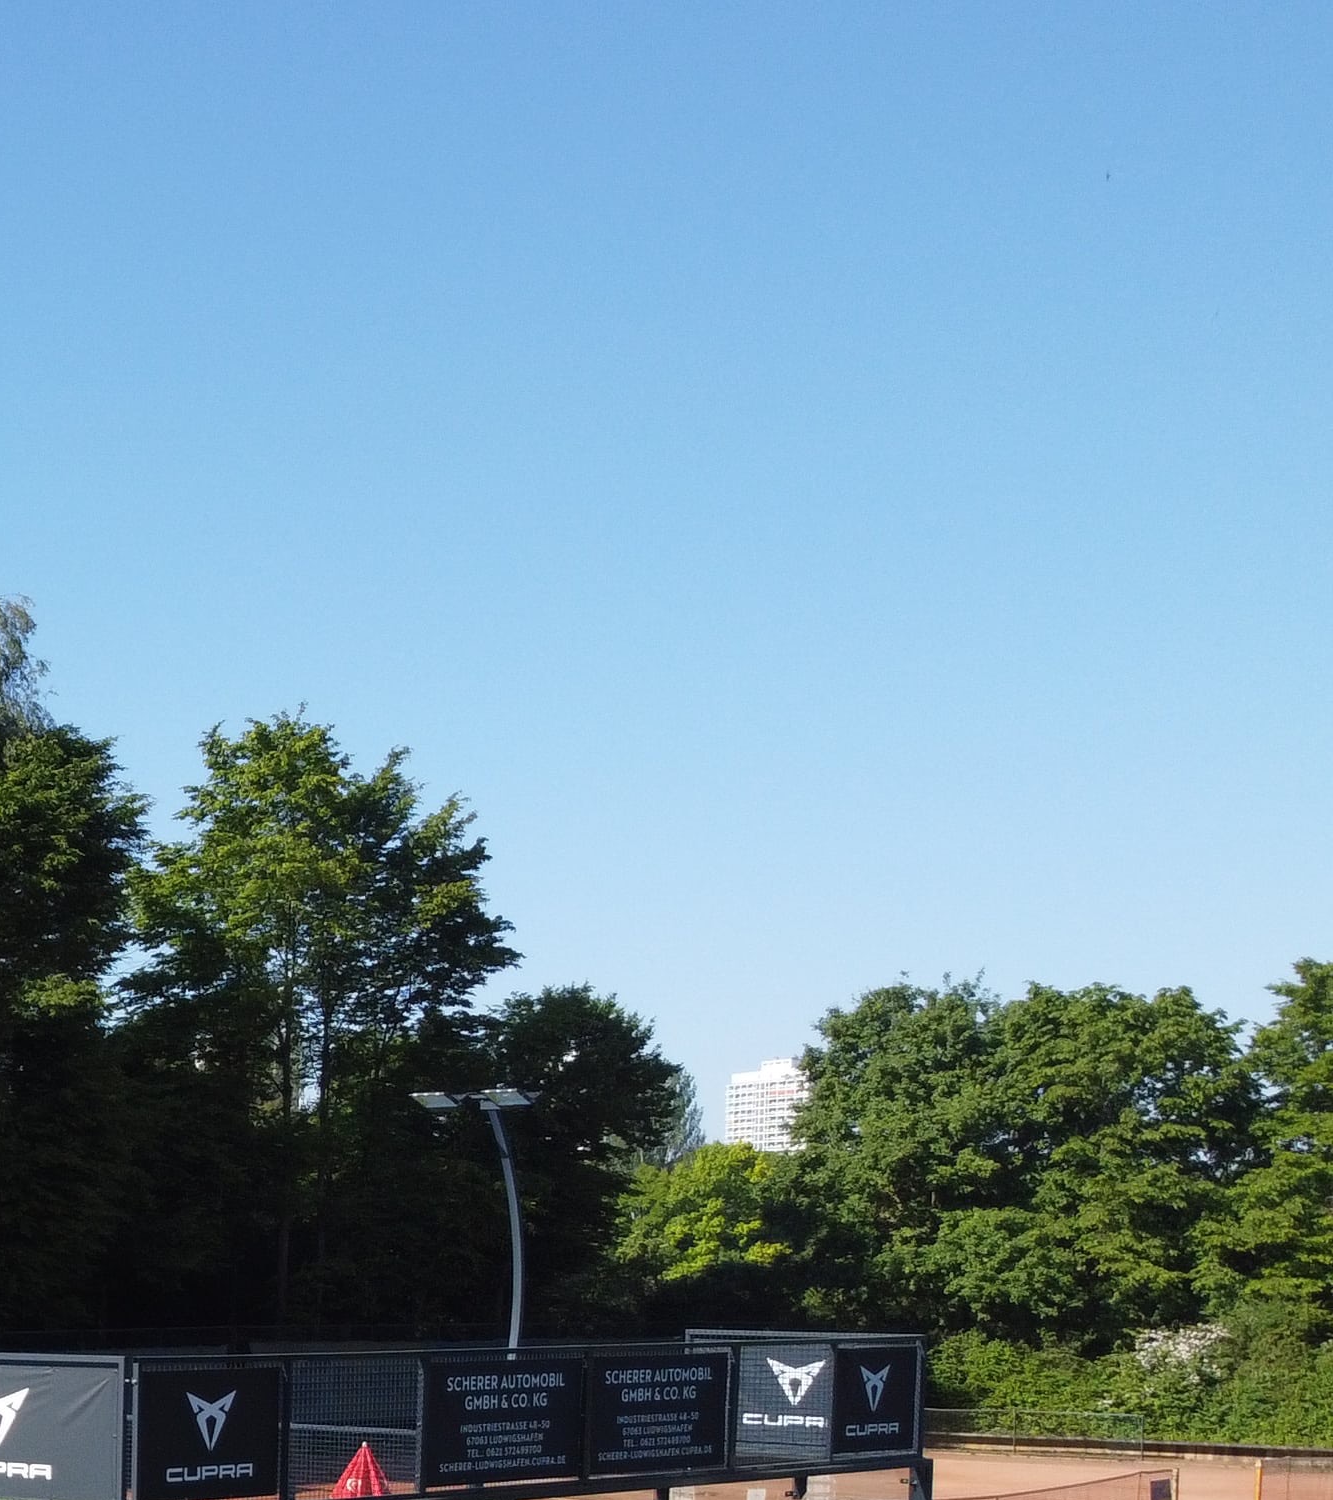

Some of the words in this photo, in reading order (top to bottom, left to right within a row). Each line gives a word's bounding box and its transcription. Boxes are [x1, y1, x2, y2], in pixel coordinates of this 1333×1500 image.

[446, 1374, 498, 1392] SCHERER
[500, 1372, 565, 1389] AUTOMOBIL
[605, 1369, 652, 1384] SCHERER
[653, 1367, 712, 1383] AUTOMOBIL
[464, 1394, 498, 1411] GMBH
[501, 1394, 509, 1408] &
[511, 1393, 531, 1408] CO.
[533, 1392, 548, 1407] KG
[621, 1388, 652, 1402] GMBH
[654, 1387, 661, 1400] &
[663, 1387, 681, 1400] CO.
[683, 1385, 697, 1399] KG
[460, 1421, 527, 1434] INDUSTRIESTRASSE
[845, 1422, 900, 1436] CUPRA
[466, 1436, 488, 1446] 67063
[165, 1462, 254, 1484] CUPRA
